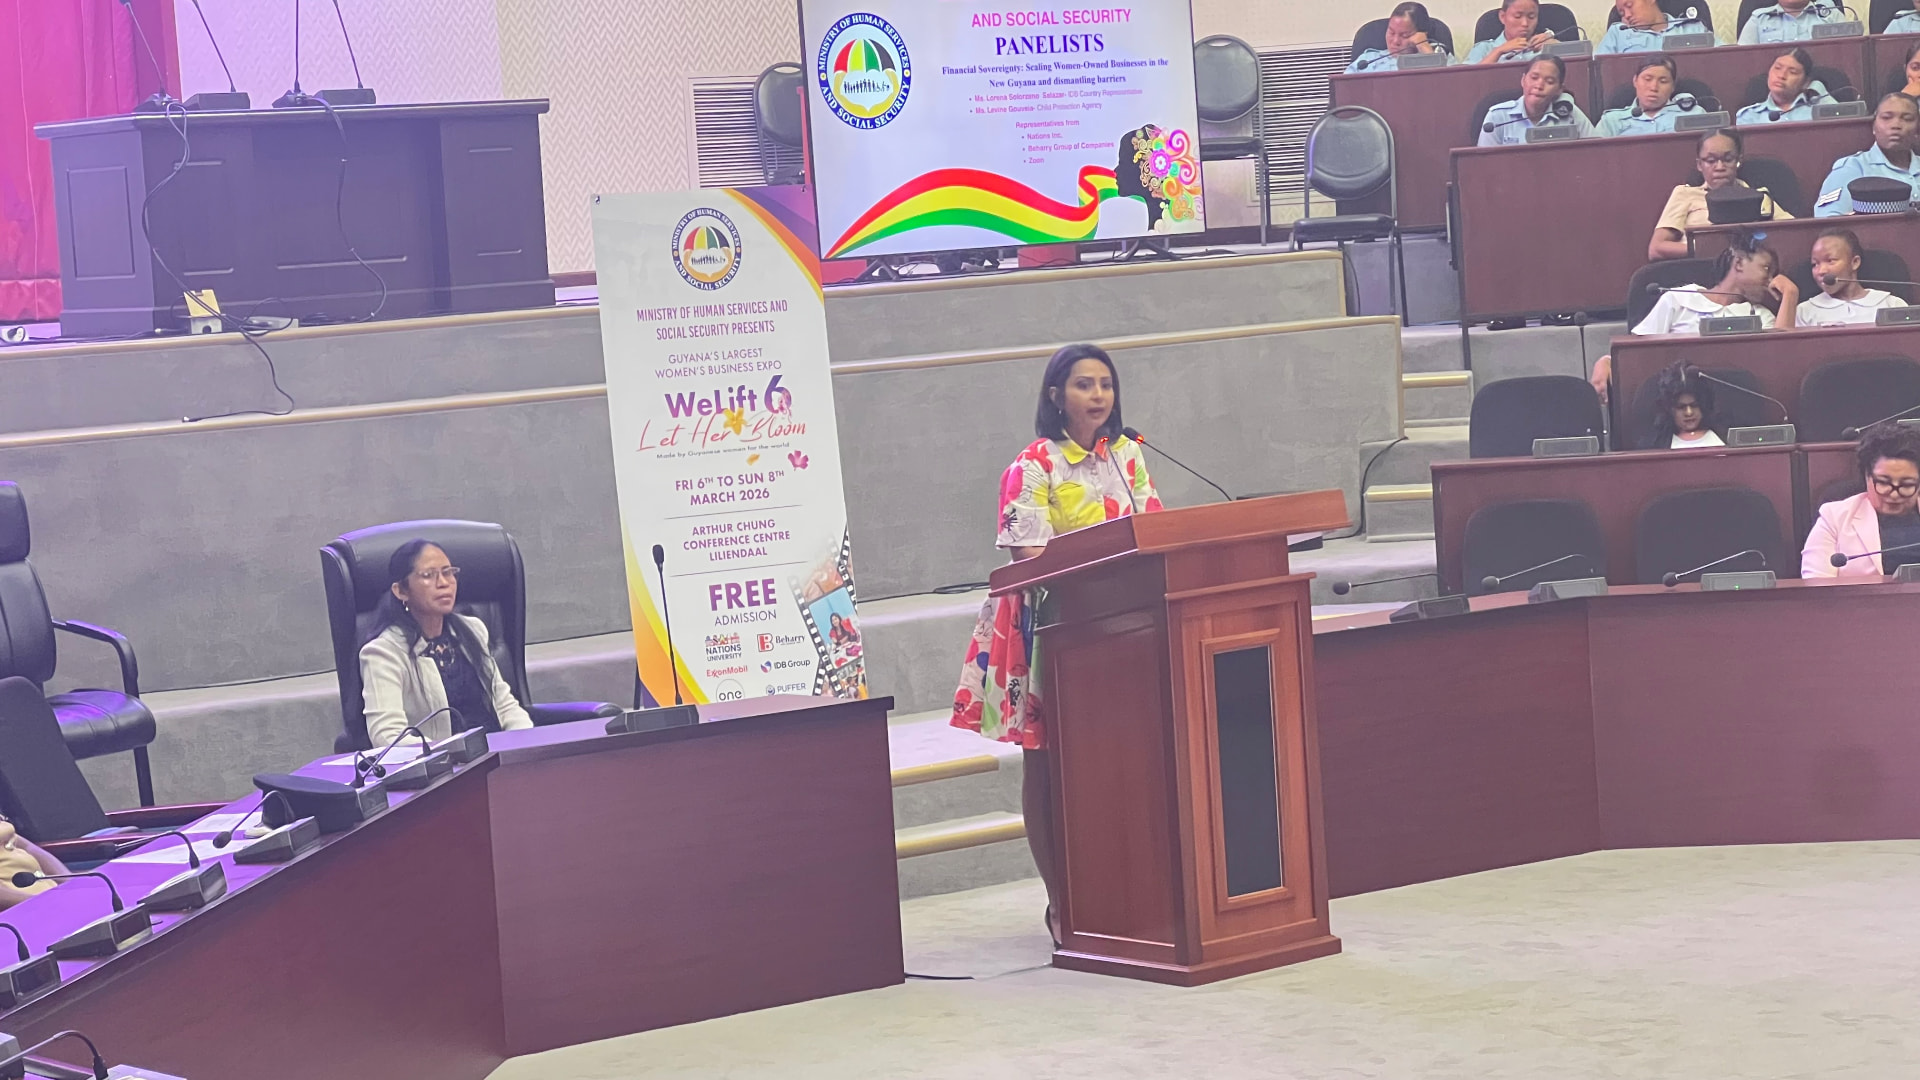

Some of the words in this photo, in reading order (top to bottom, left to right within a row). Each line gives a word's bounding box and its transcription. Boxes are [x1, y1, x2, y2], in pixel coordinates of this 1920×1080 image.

[972, 13, 1001, 27] AND
[1006, 11, 1059, 26] SOCIAL
[1063, 9, 1131, 24] SECURITY
[819, 24, 840, 71] MINISTRY
[840, 17, 851, 28] OF
[851, 14, 885, 28] HUMAN
[883, 24, 910, 68] SERVICES
[995, 34, 1104, 55] PANELISTS
[942, 65, 977, 75] Financial
[978, 63, 1024, 75] Sovereignty:
[1025, 62, 1052, 73] Scaling
[1053, 60, 1109, 70] Women-Owned
[1110, 58, 1147, 68] Businesses
[1149, 58, 1156, 67] in
[1157, 57, 1169, 66] the
[989, 79, 1005, 88] New
[1007, 77, 1036, 88] Guyana
[1038, 77, 1052, 86] and
[1053, 75, 1096, 86] dismantling
[1097, 74, 1126, 84] barriers
[820, 86, 838, 109] AND
[837, 107, 873, 129] SOCIAL
[875, 80, 910, 128] SECURITY
[1036, 103, 1051, 111] Child
[1052, 102, 1080, 110] Protection
[1015, 120, 1064, 129] Representatives
[1065, 119, 1080, 127] from
[1027, 132, 1050, 140] Nations
[1053, 142, 1072, 151] Group
[1080, 140, 1114, 150] Companies
[672, 216, 688, 249] MINISTRY
[696, 208, 721, 218] HUMAN
[720, 215, 740, 247] SERVICES
[674, 260, 687, 277] AND
[686, 275, 714, 290] SOCIAL
[714, 257, 741, 288] SECURITY
[636, 306, 678, 322] MINISTRY
[680, 305, 692, 319] OF
[693, 303, 725, 318] HUMAN
[727, 300, 768, 316] SERVICES
[770, 299, 788, 312] AND
[656, 324, 687, 341] SOCIAL
[689, 322, 730, 338] SECURITY
[732, 319, 775, 335] PRESENTS
[668, 351, 719, 364] GUYANA'S
[722, 347, 763, 360] LARGEST
[655, 365, 706, 379] WOMEN'S
[708, 361, 754, 375] BUSINESS
[756, 359, 782, 372] EXPO
[664, 384, 757, 418] WeLift
[764, 374, 792, 414] 6
[636, 419, 686, 452] Let
[688, 412, 732, 449] Her
[739, 412, 806, 443] Bloom
[656, 451, 676, 460] Made
[677, 451, 686, 459] by
[770, 442, 790, 450] world
[675, 478, 693, 491] FRI
[717, 475, 734, 487] TO
[738, 472, 764, 485] SUN
[690, 491, 736, 506] MARCH
[739, 488, 770, 501] 2026
[692, 523, 733, 536] ARTHUR
[736, 519, 776, 532] CHUNG
[683, 535, 752, 551] CONFERENCE
[753, 531, 790, 543] CENTRE
[709, 546, 768, 562] LILIENDAAL
[708, 578, 777, 612] FREE
[714, 610, 777, 627] ADMISSION
[775, 634, 805, 644] Beharry
[706, 644, 742, 655] NATIONS
[707, 652, 742, 662] UNIVERSITY
[706, 665, 748, 678] ExxonMobil
[774, 661, 787, 670] IDB
[787, 659, 811, 668] Group
[718, 690, 742, 701] one
[777, 683, 806, 693] PUFFER
